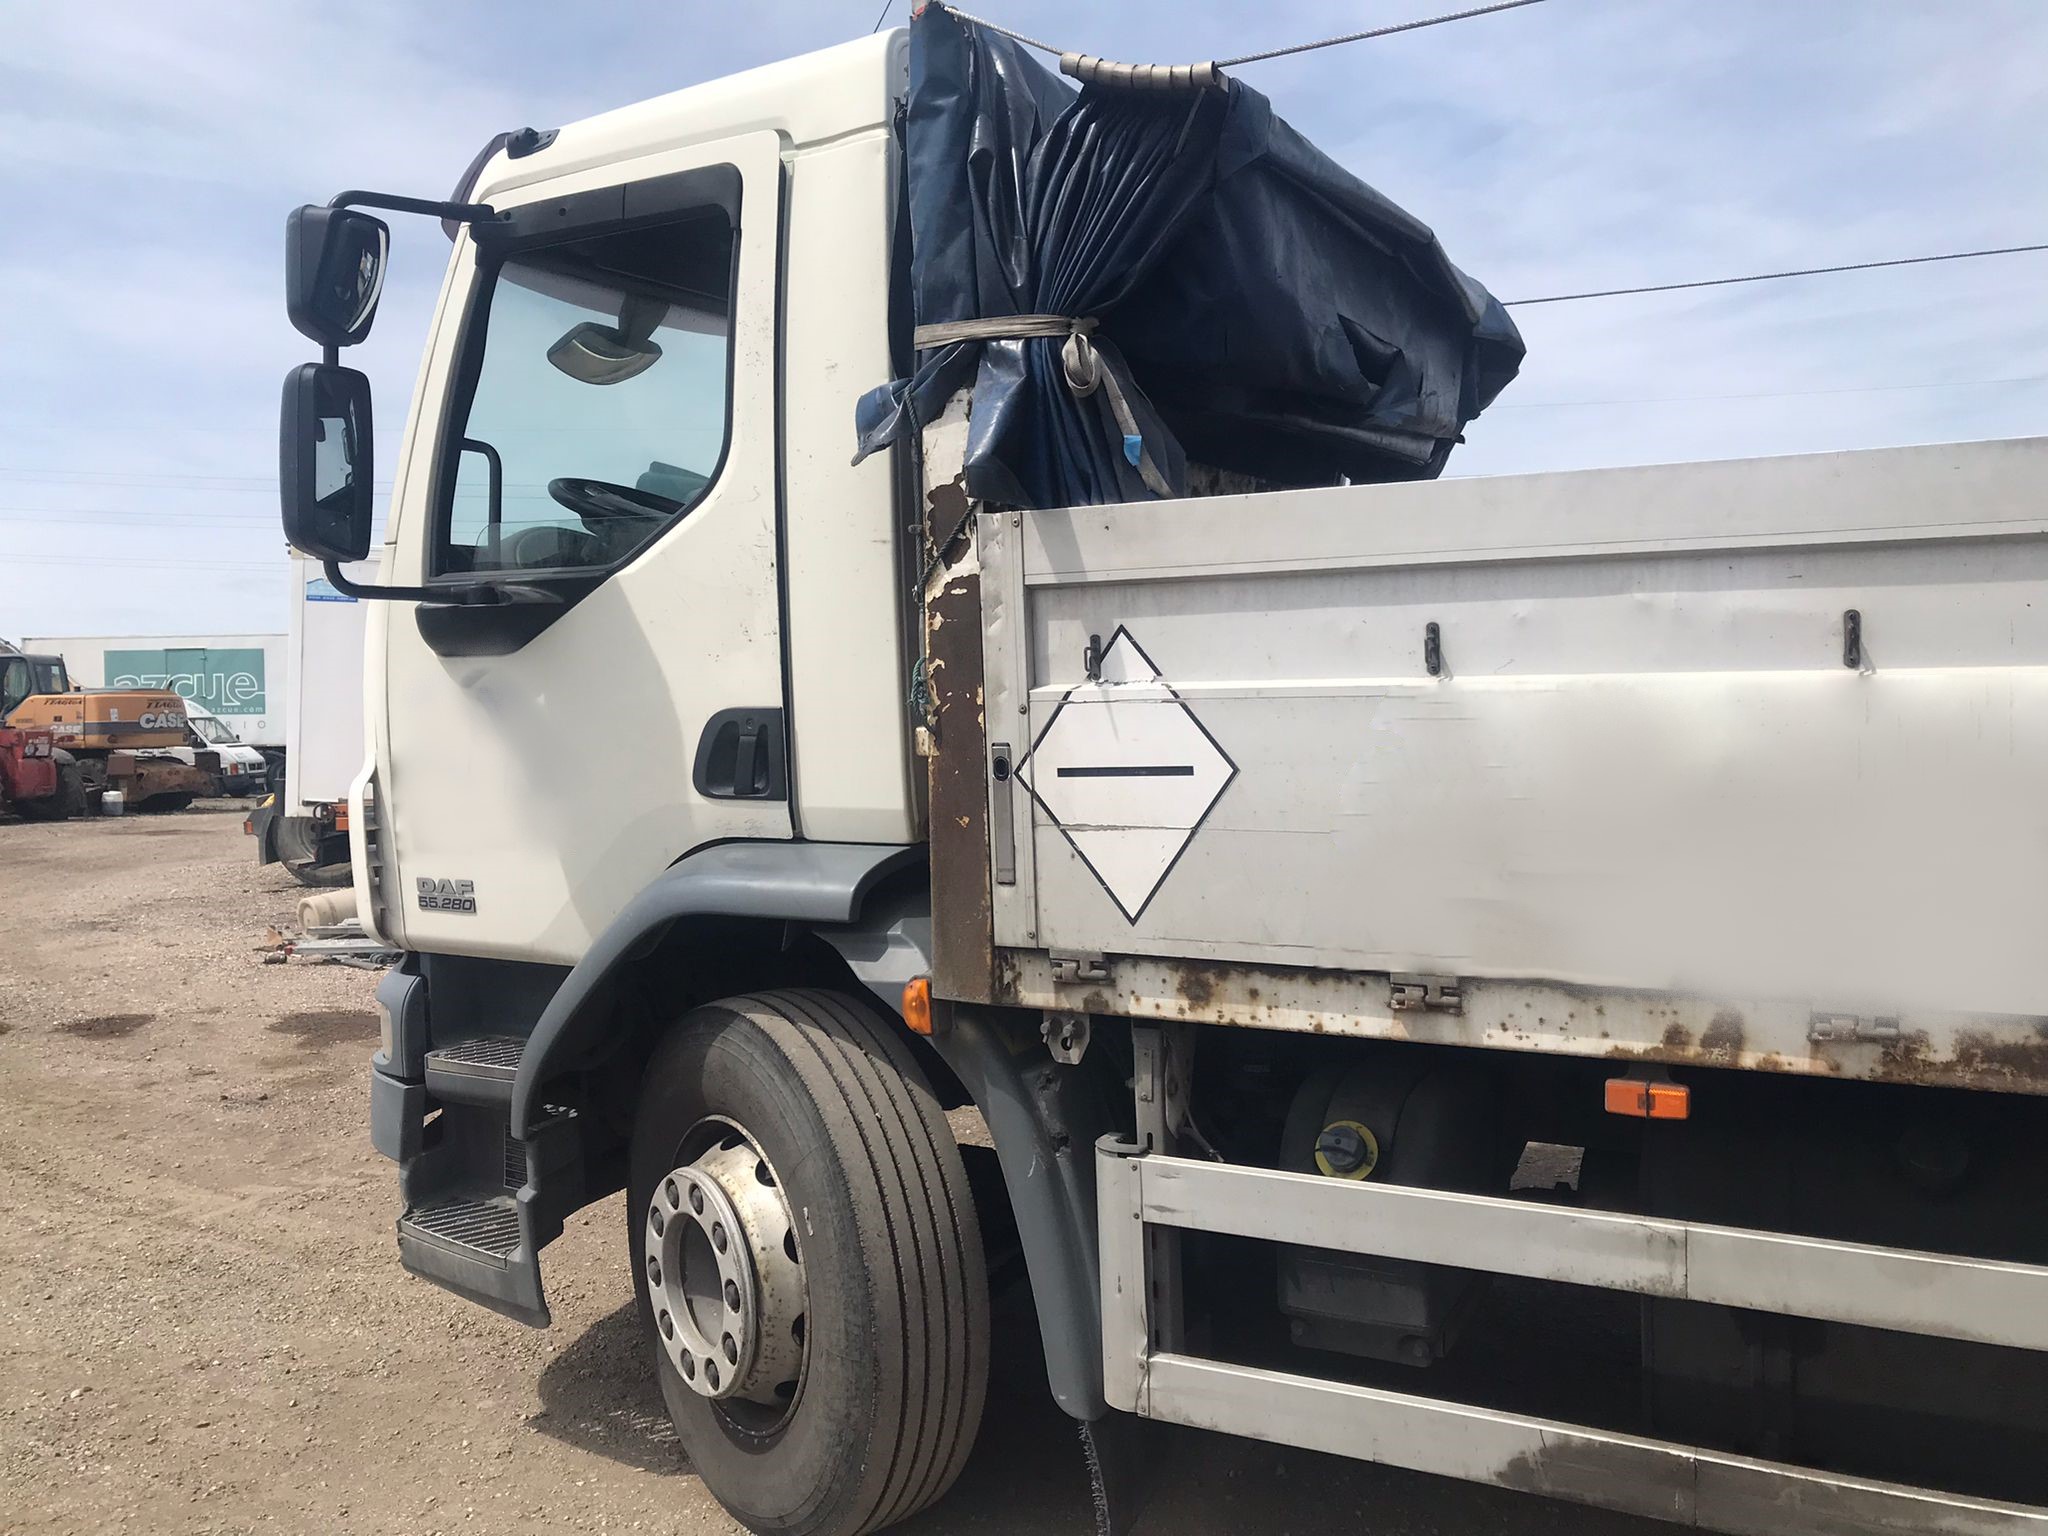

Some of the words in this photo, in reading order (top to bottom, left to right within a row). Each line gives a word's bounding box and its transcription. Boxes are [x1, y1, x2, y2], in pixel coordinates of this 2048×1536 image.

[210, 705, 263, 714] azcue.com
[139, 714, 185, 729] CASE
[416, 877, 474, 896] DAF
[418, 895, 473, 911] 55.280
